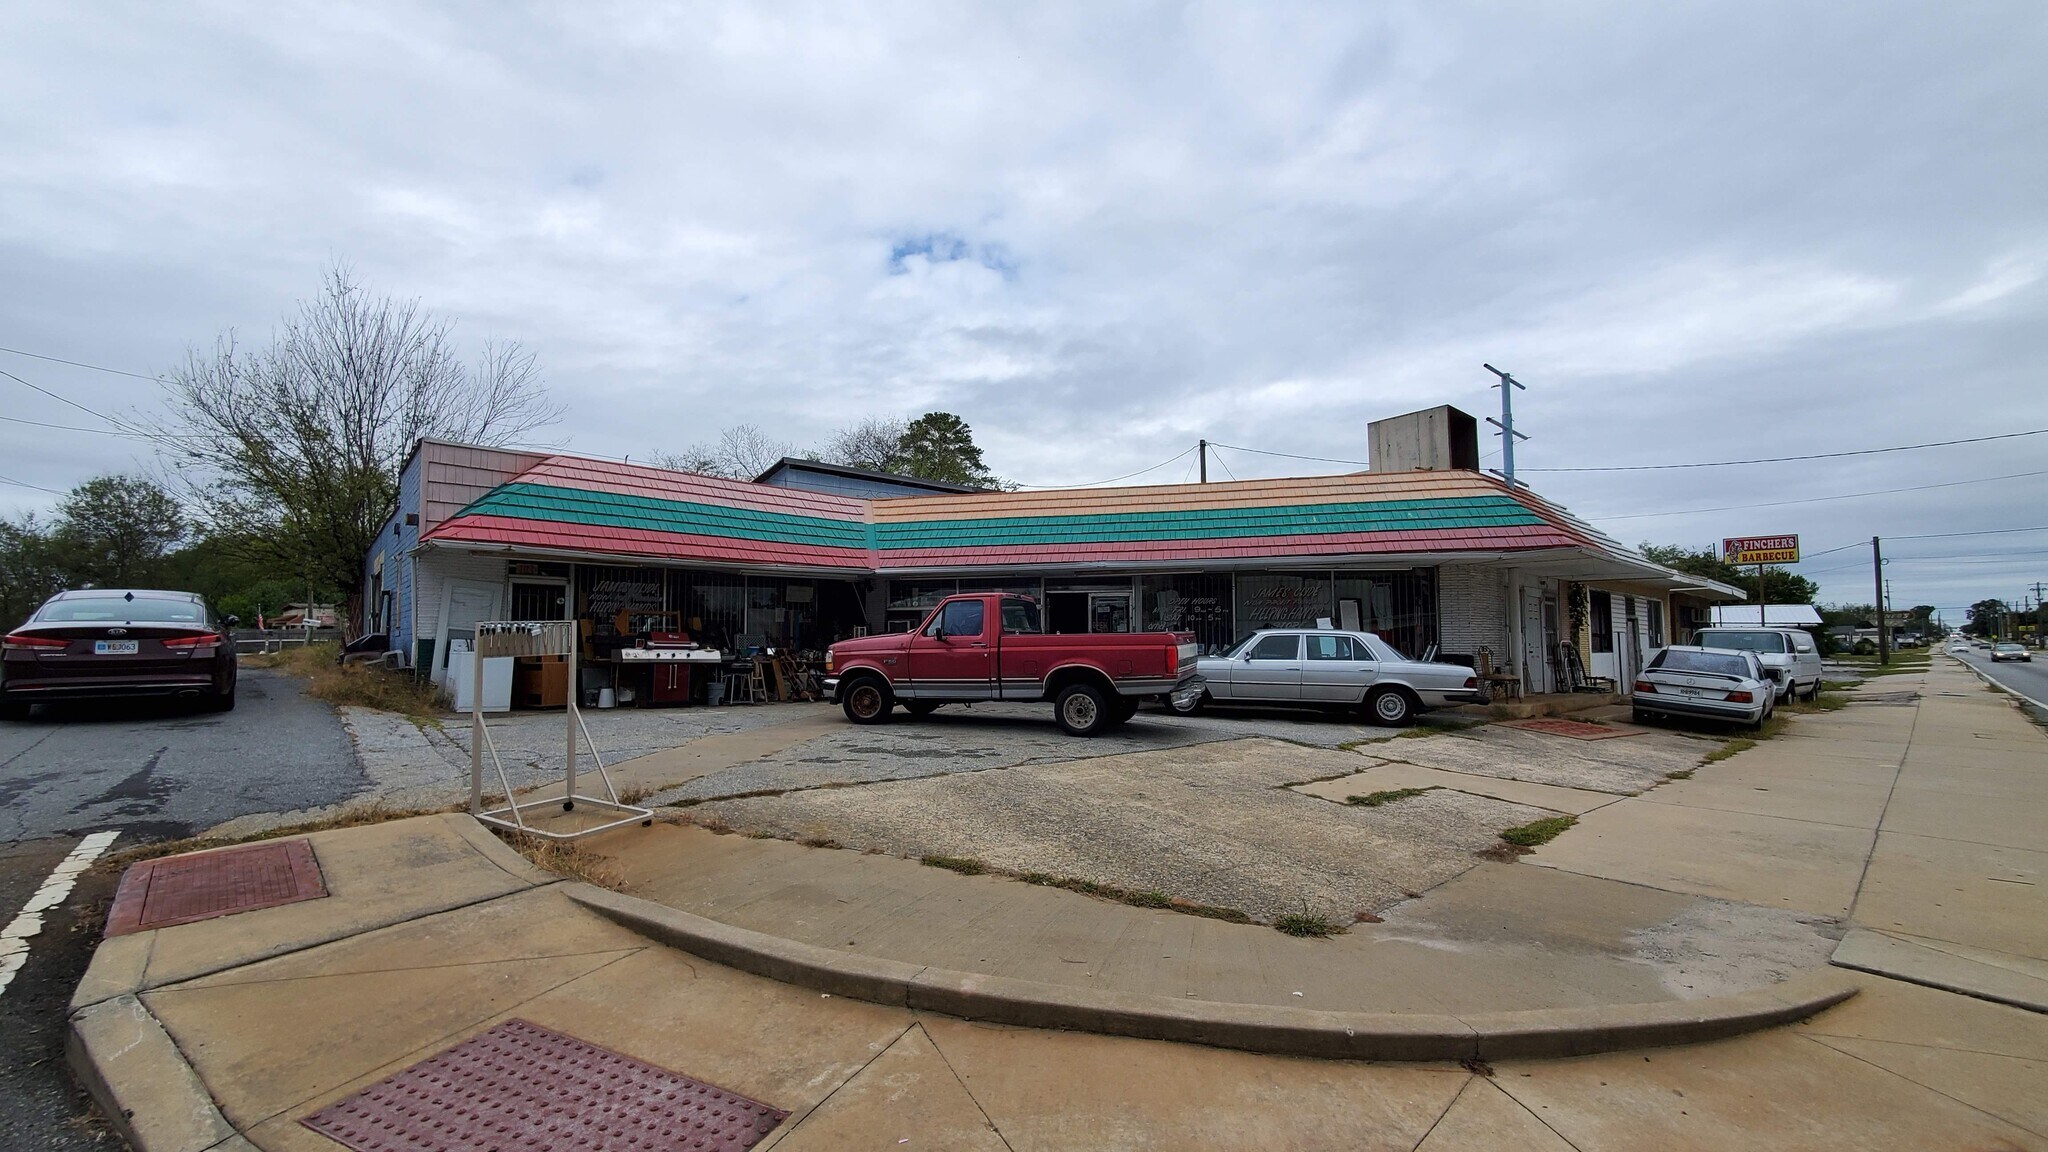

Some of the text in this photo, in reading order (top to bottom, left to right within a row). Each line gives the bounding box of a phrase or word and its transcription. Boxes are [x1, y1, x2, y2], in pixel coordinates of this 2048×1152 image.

[1743, 538, 1795, 550] FINCHER'S
[1742, 551, 1795, 562] BARBECUE
[1191, 597, 1217, 605] HOURS
